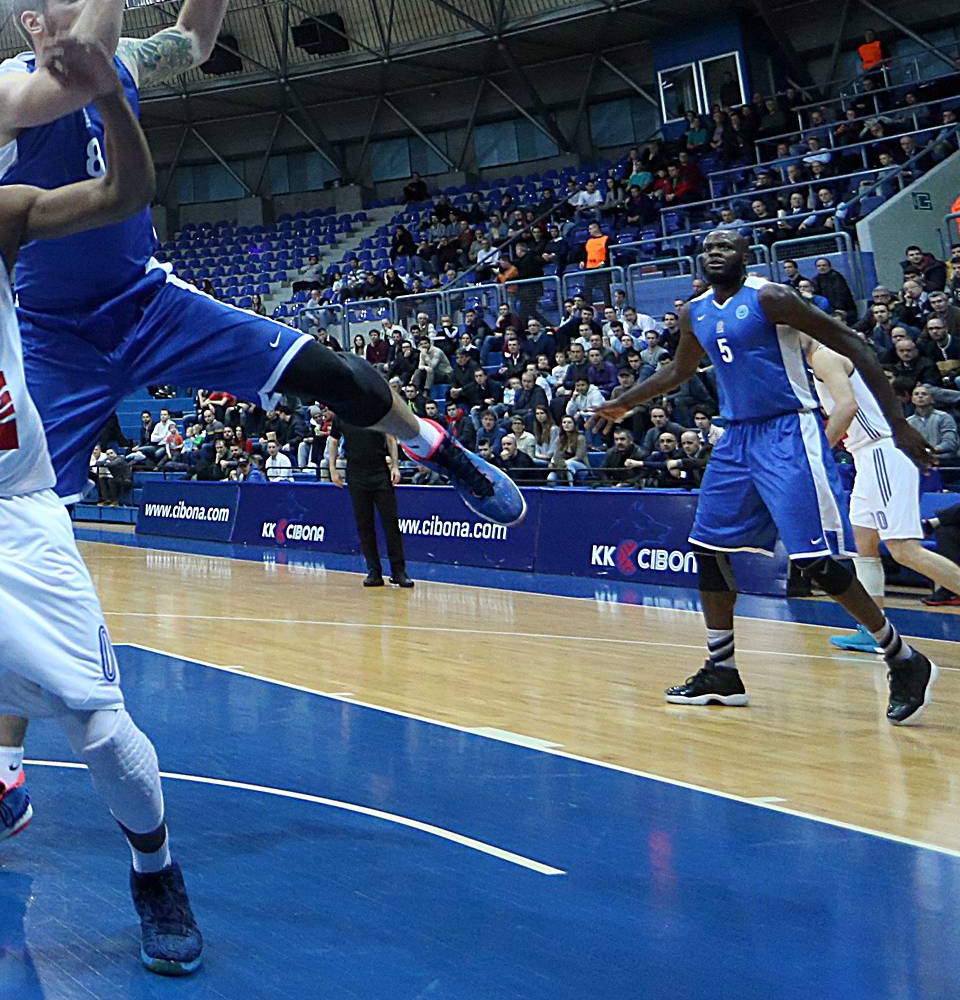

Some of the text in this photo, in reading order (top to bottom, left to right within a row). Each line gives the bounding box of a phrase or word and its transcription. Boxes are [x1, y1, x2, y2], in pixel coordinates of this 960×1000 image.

[716, 337, 733, 363] 5
[144, 500, 230, 522] www.cibona.com
[261, 521, 326, 542] KK CIBONA
[397, 515, 508, 540] ww.cibona.com
[591, 544, 698, 574] KK CIBON
